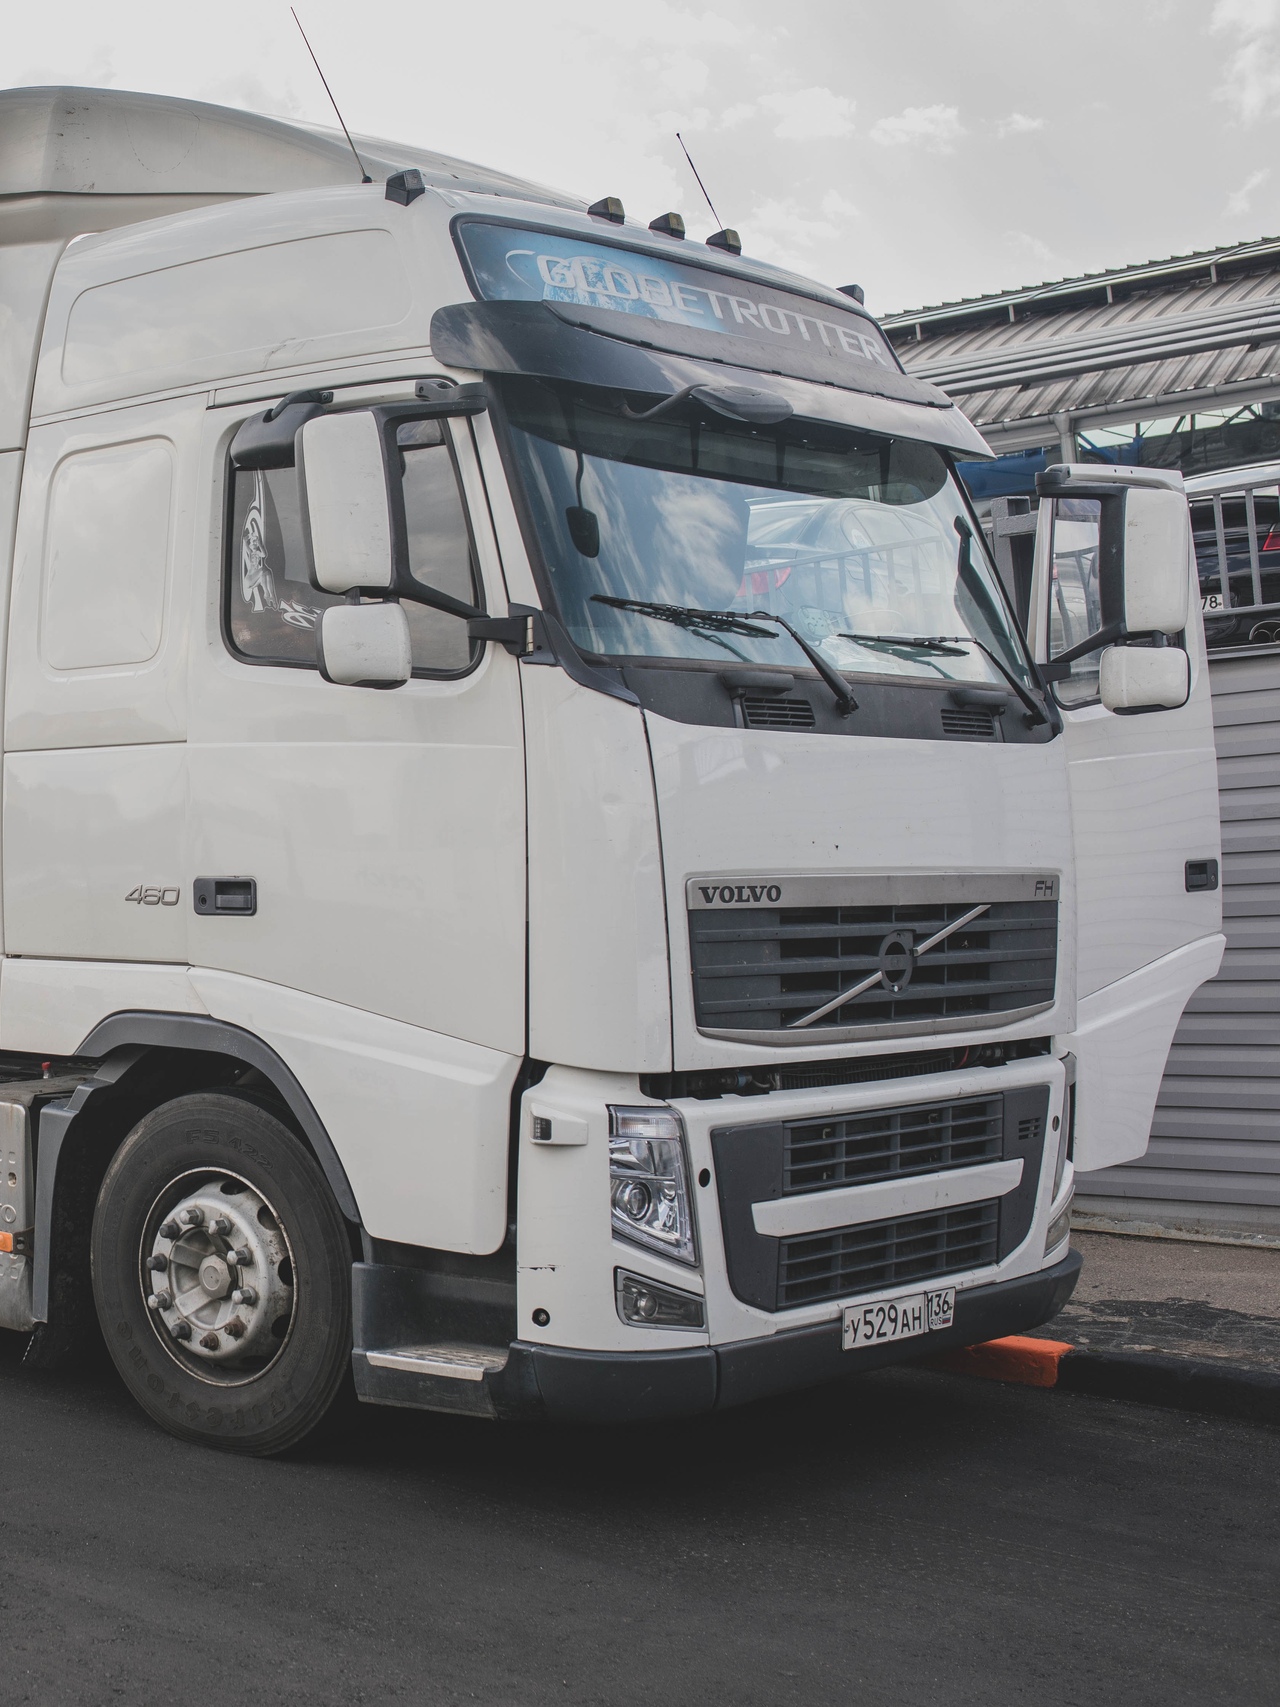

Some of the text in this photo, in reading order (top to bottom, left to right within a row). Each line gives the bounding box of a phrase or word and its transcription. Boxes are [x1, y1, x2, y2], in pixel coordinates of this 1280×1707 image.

[536, 254, 888, 367] GLOBETROTTER
[125, 884, 181, 906] 460
[698, 880, 1054, 904] VOLVO FH
[185, 1128, 220, 1145] FS
[927, 1292, 950, 1318] 136
